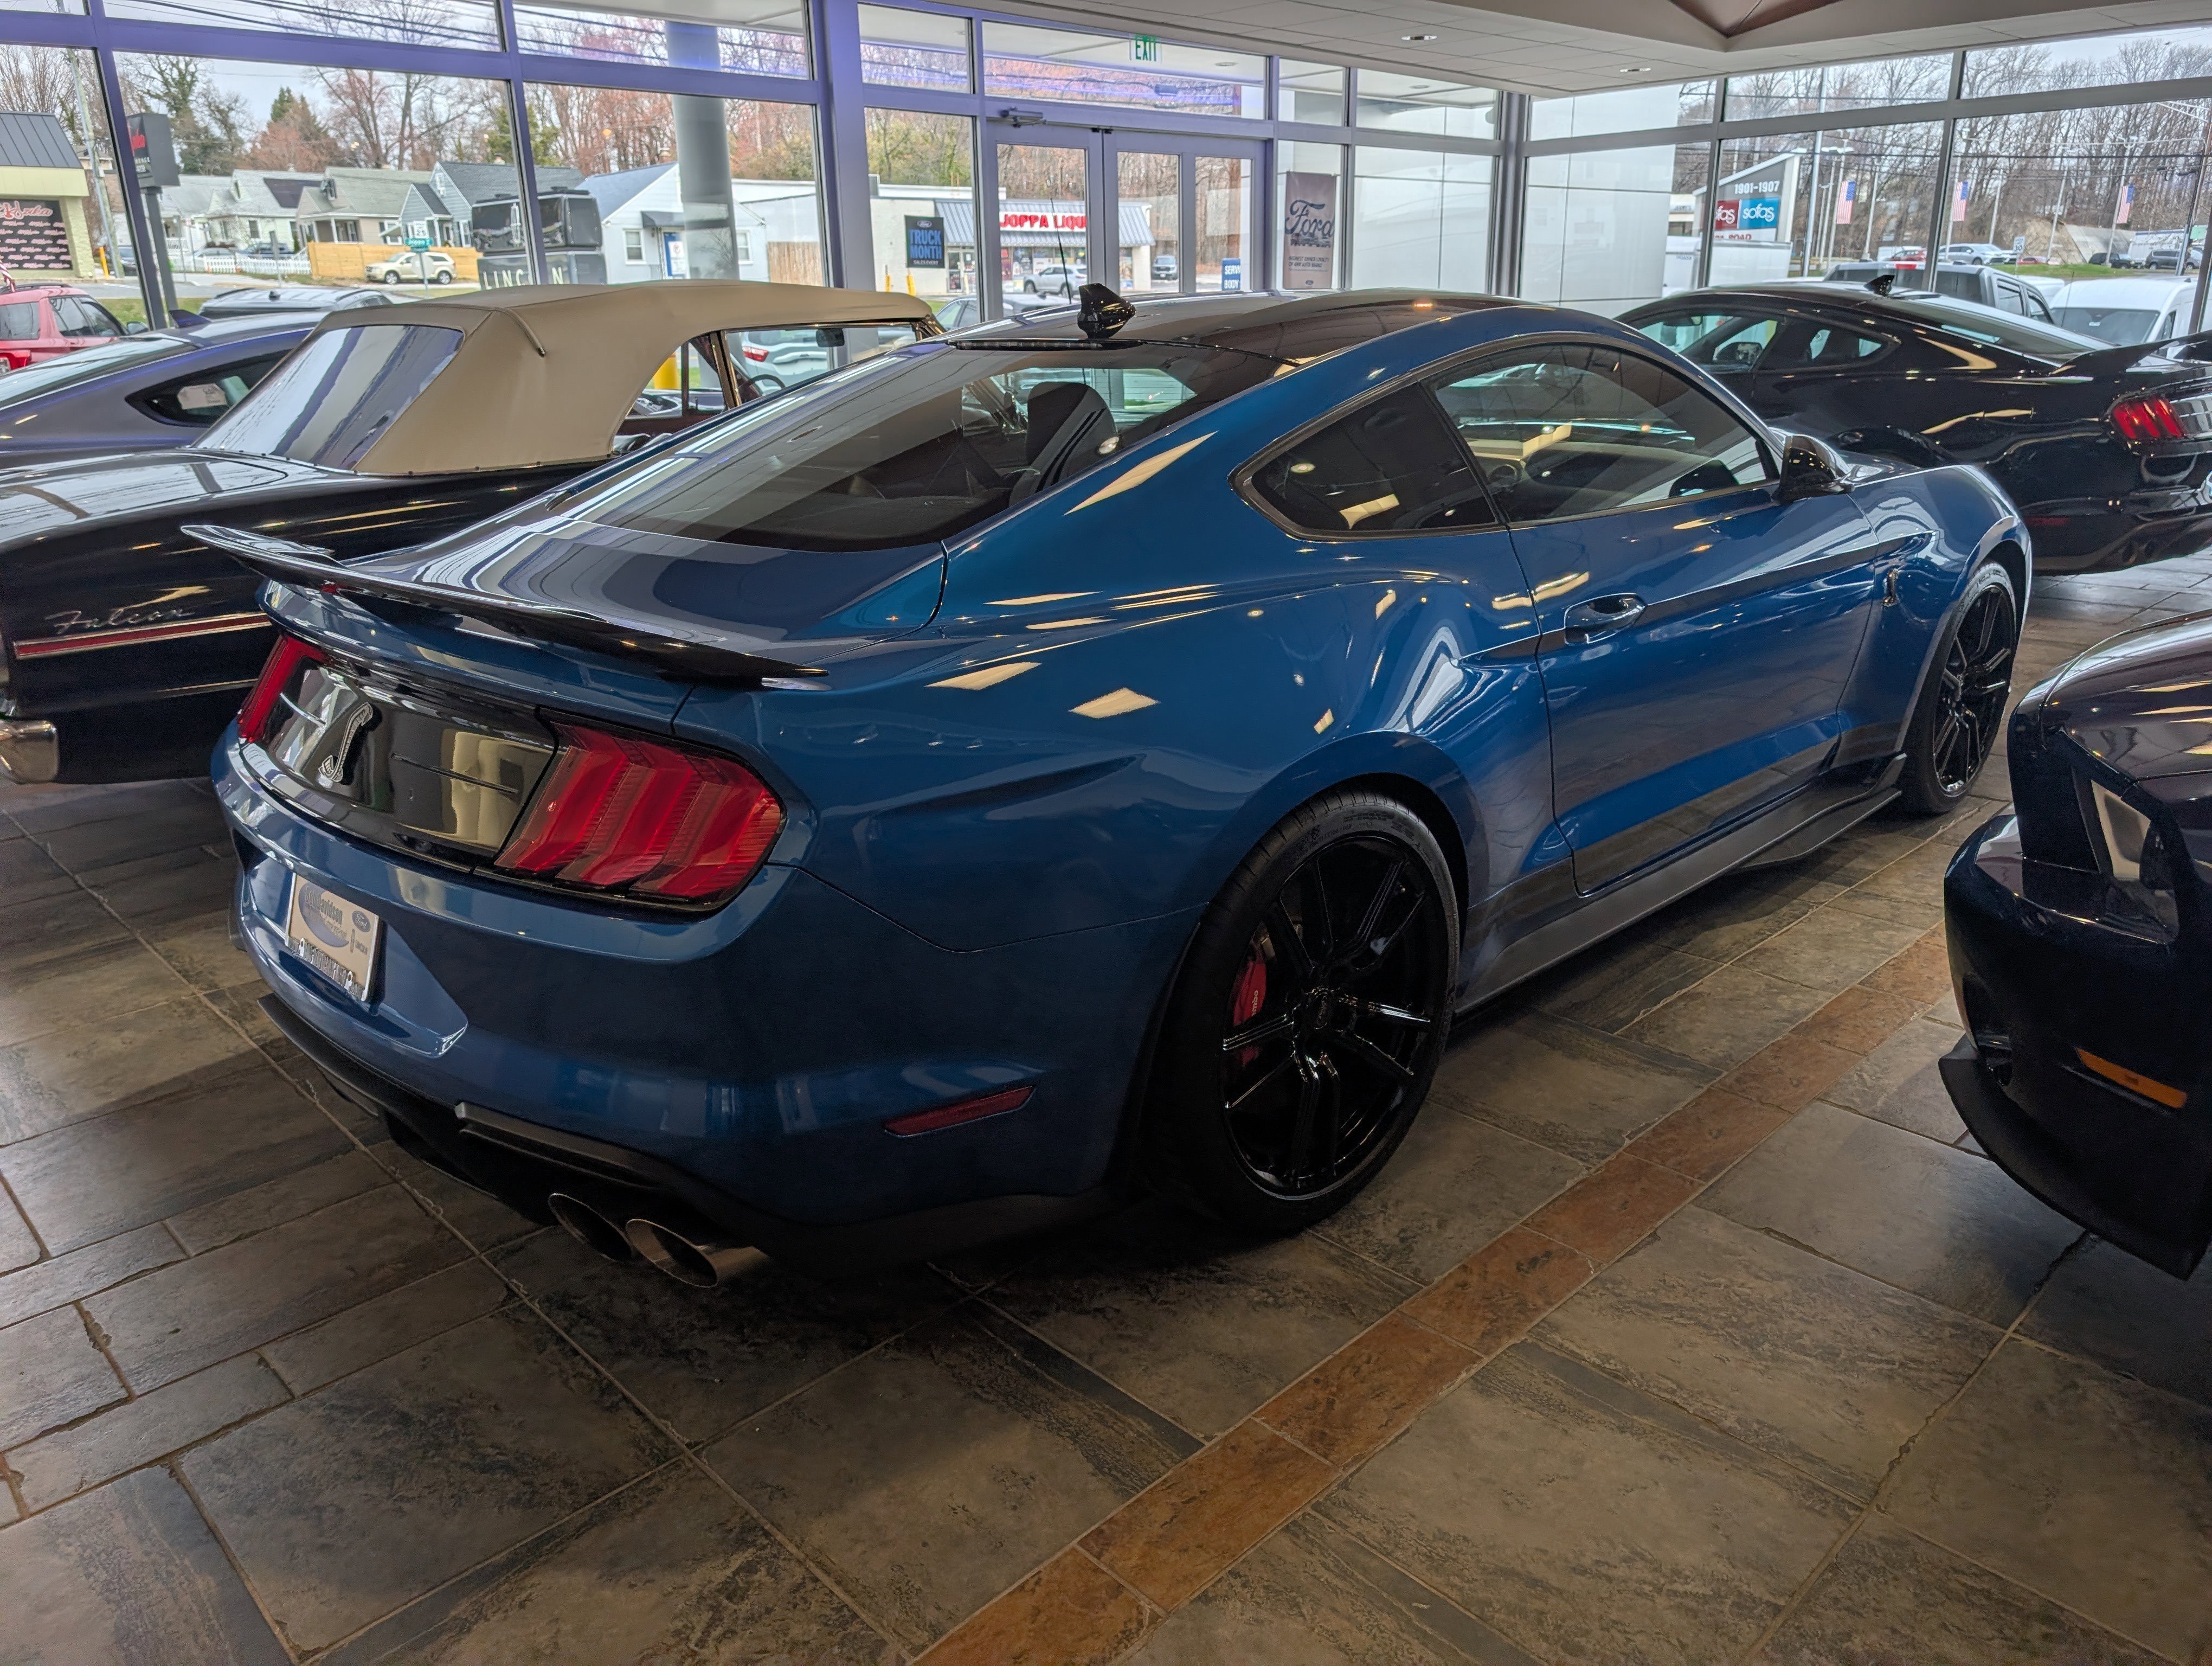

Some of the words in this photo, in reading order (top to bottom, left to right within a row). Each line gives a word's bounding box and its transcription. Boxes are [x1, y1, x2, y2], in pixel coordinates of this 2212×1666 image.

[1135, 35, 1156, 61] EXIT
[1735, 181, 1779, 194] 1901-1907
[1285, 200, 1335, 238] Ford
[1742, 203, 1774, 222] sofas
[999, 214, 1049, 228] JOPPA
[1053, 215, 1087, 230] LIQU
[909, 229, 941, 245] TRUCK
[910, 245, 942, 259] MONTH
[483, 267, 564, 290] LINCN
[44, 608, 195, 635] Falcon
[355, 913, 368, 929] Ford
